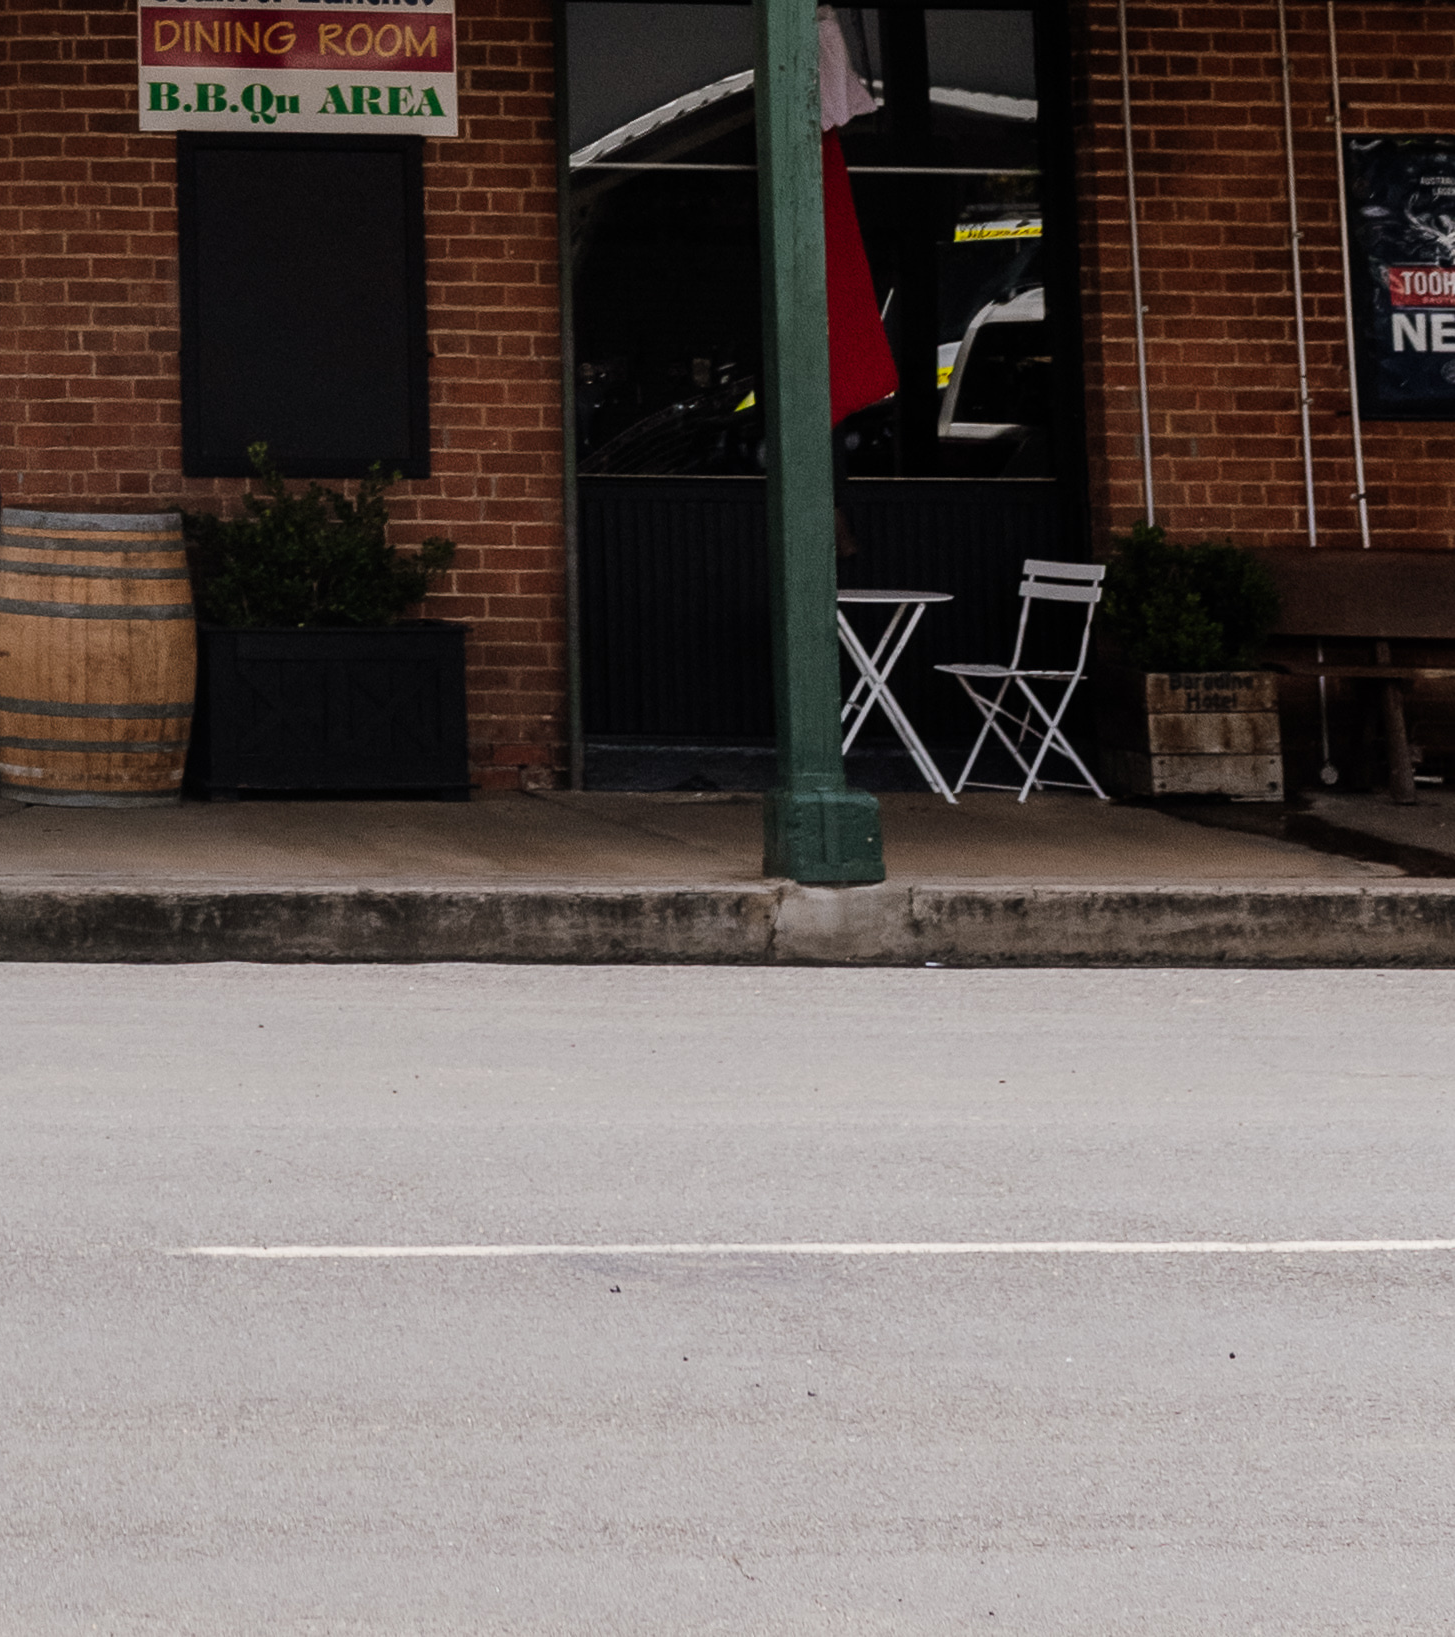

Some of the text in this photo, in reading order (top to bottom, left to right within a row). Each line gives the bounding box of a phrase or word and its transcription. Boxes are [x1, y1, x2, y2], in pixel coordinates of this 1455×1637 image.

[153, 18, 438, 58] DINING ROOM
[146, 81, 447, 125] B.B.Qu AREA
[1392, 312, 1455, 352] NE
[1186, 692, 1237, 709] Hotel
